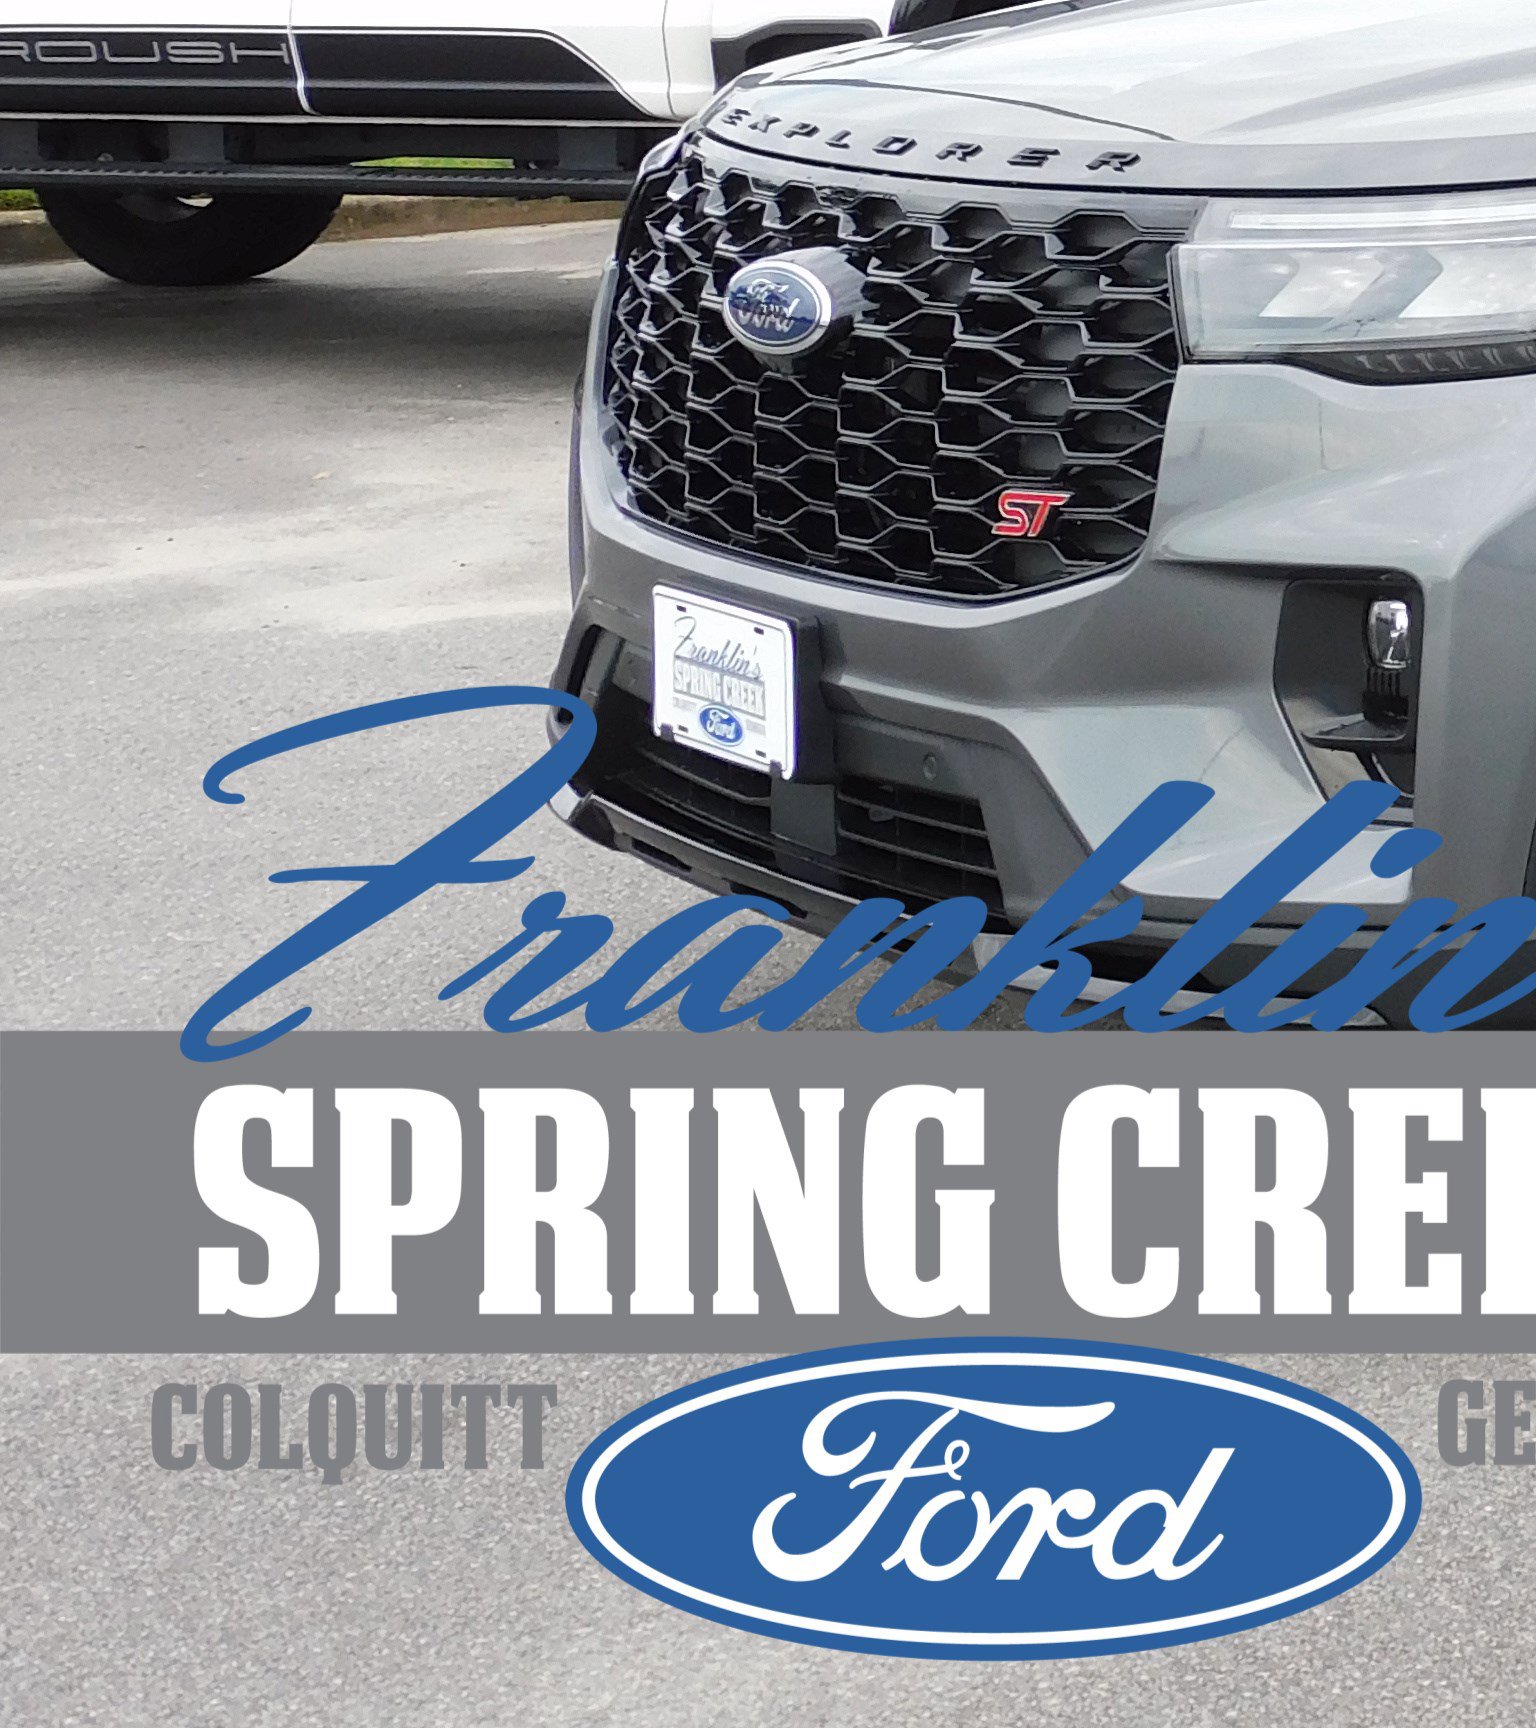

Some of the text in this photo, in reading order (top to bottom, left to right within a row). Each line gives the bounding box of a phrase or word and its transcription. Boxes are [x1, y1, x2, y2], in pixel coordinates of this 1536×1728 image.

[720, 107, 1141, 172] EXPLORER
[991, 488, 1073, 537] ST
[673, 616, 764, 682] Franklin's
[674, 661, 721, 702] SPRING
[723, 675, 765, 717] CREEK
[707, 710, 736, 740] Ford
